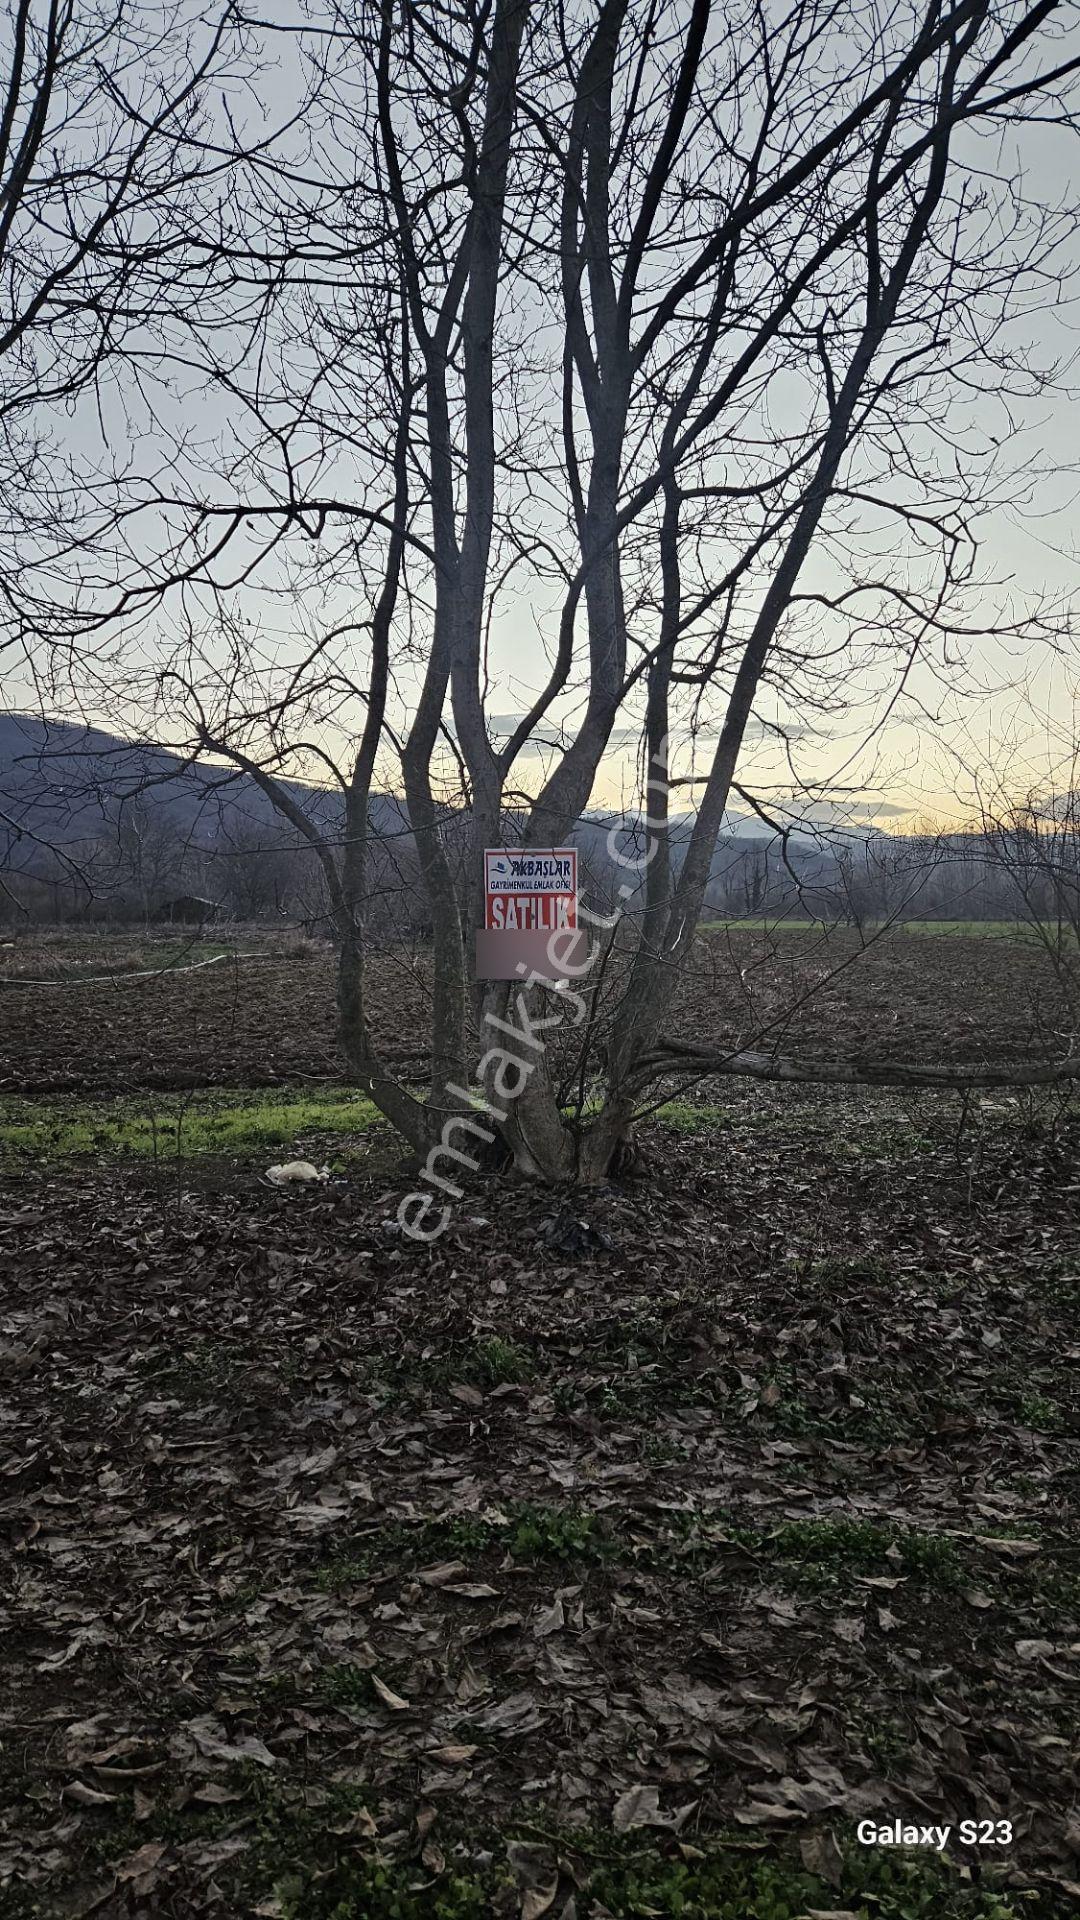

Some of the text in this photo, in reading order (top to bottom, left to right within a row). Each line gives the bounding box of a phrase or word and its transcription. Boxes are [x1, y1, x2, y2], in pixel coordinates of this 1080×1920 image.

[511, 861, 571, 878] AKBAŞLAR
[534, 880, 554, 890] EMLAK
[492, 897, 570, 929] SATILIK
